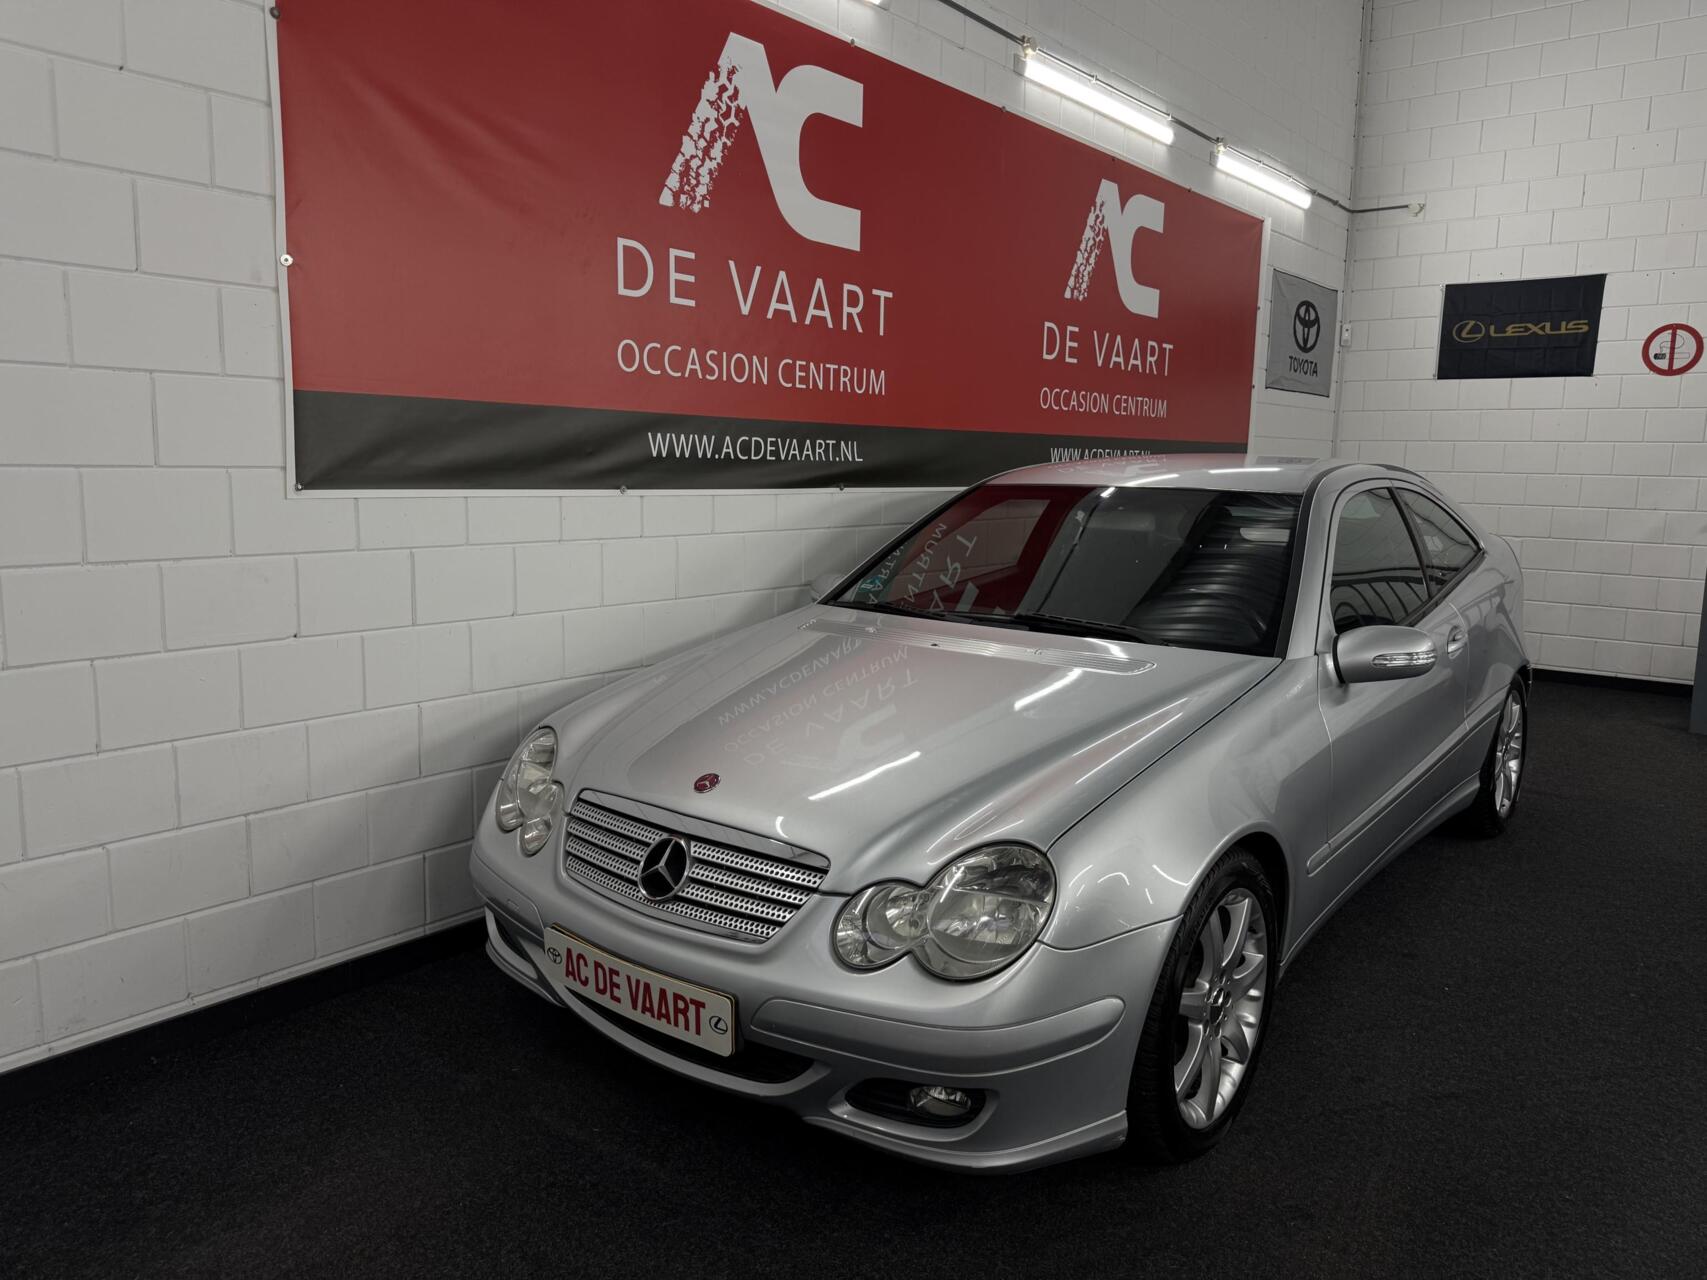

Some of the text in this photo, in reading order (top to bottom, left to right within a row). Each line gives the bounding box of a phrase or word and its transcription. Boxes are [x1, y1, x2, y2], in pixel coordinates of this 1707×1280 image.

[659, 32, 863, 252] AC
[617, 237, 893, 336] DE VAART
[1042, 321, 1174, 377] DE VAART
[1489, 319, 1591, 337] LEXUS
[617, 339, 886, 396] OCCASION CENTRUM
[1288, 355, 1318, 377] TOYOTA
[1040, 387, 1168, 419] OCCASION CENTRUM
[648, 432, 864, 462] WWW.ACDEVAART.NL
[565, 947, 706, 1036] AC DE VAART
